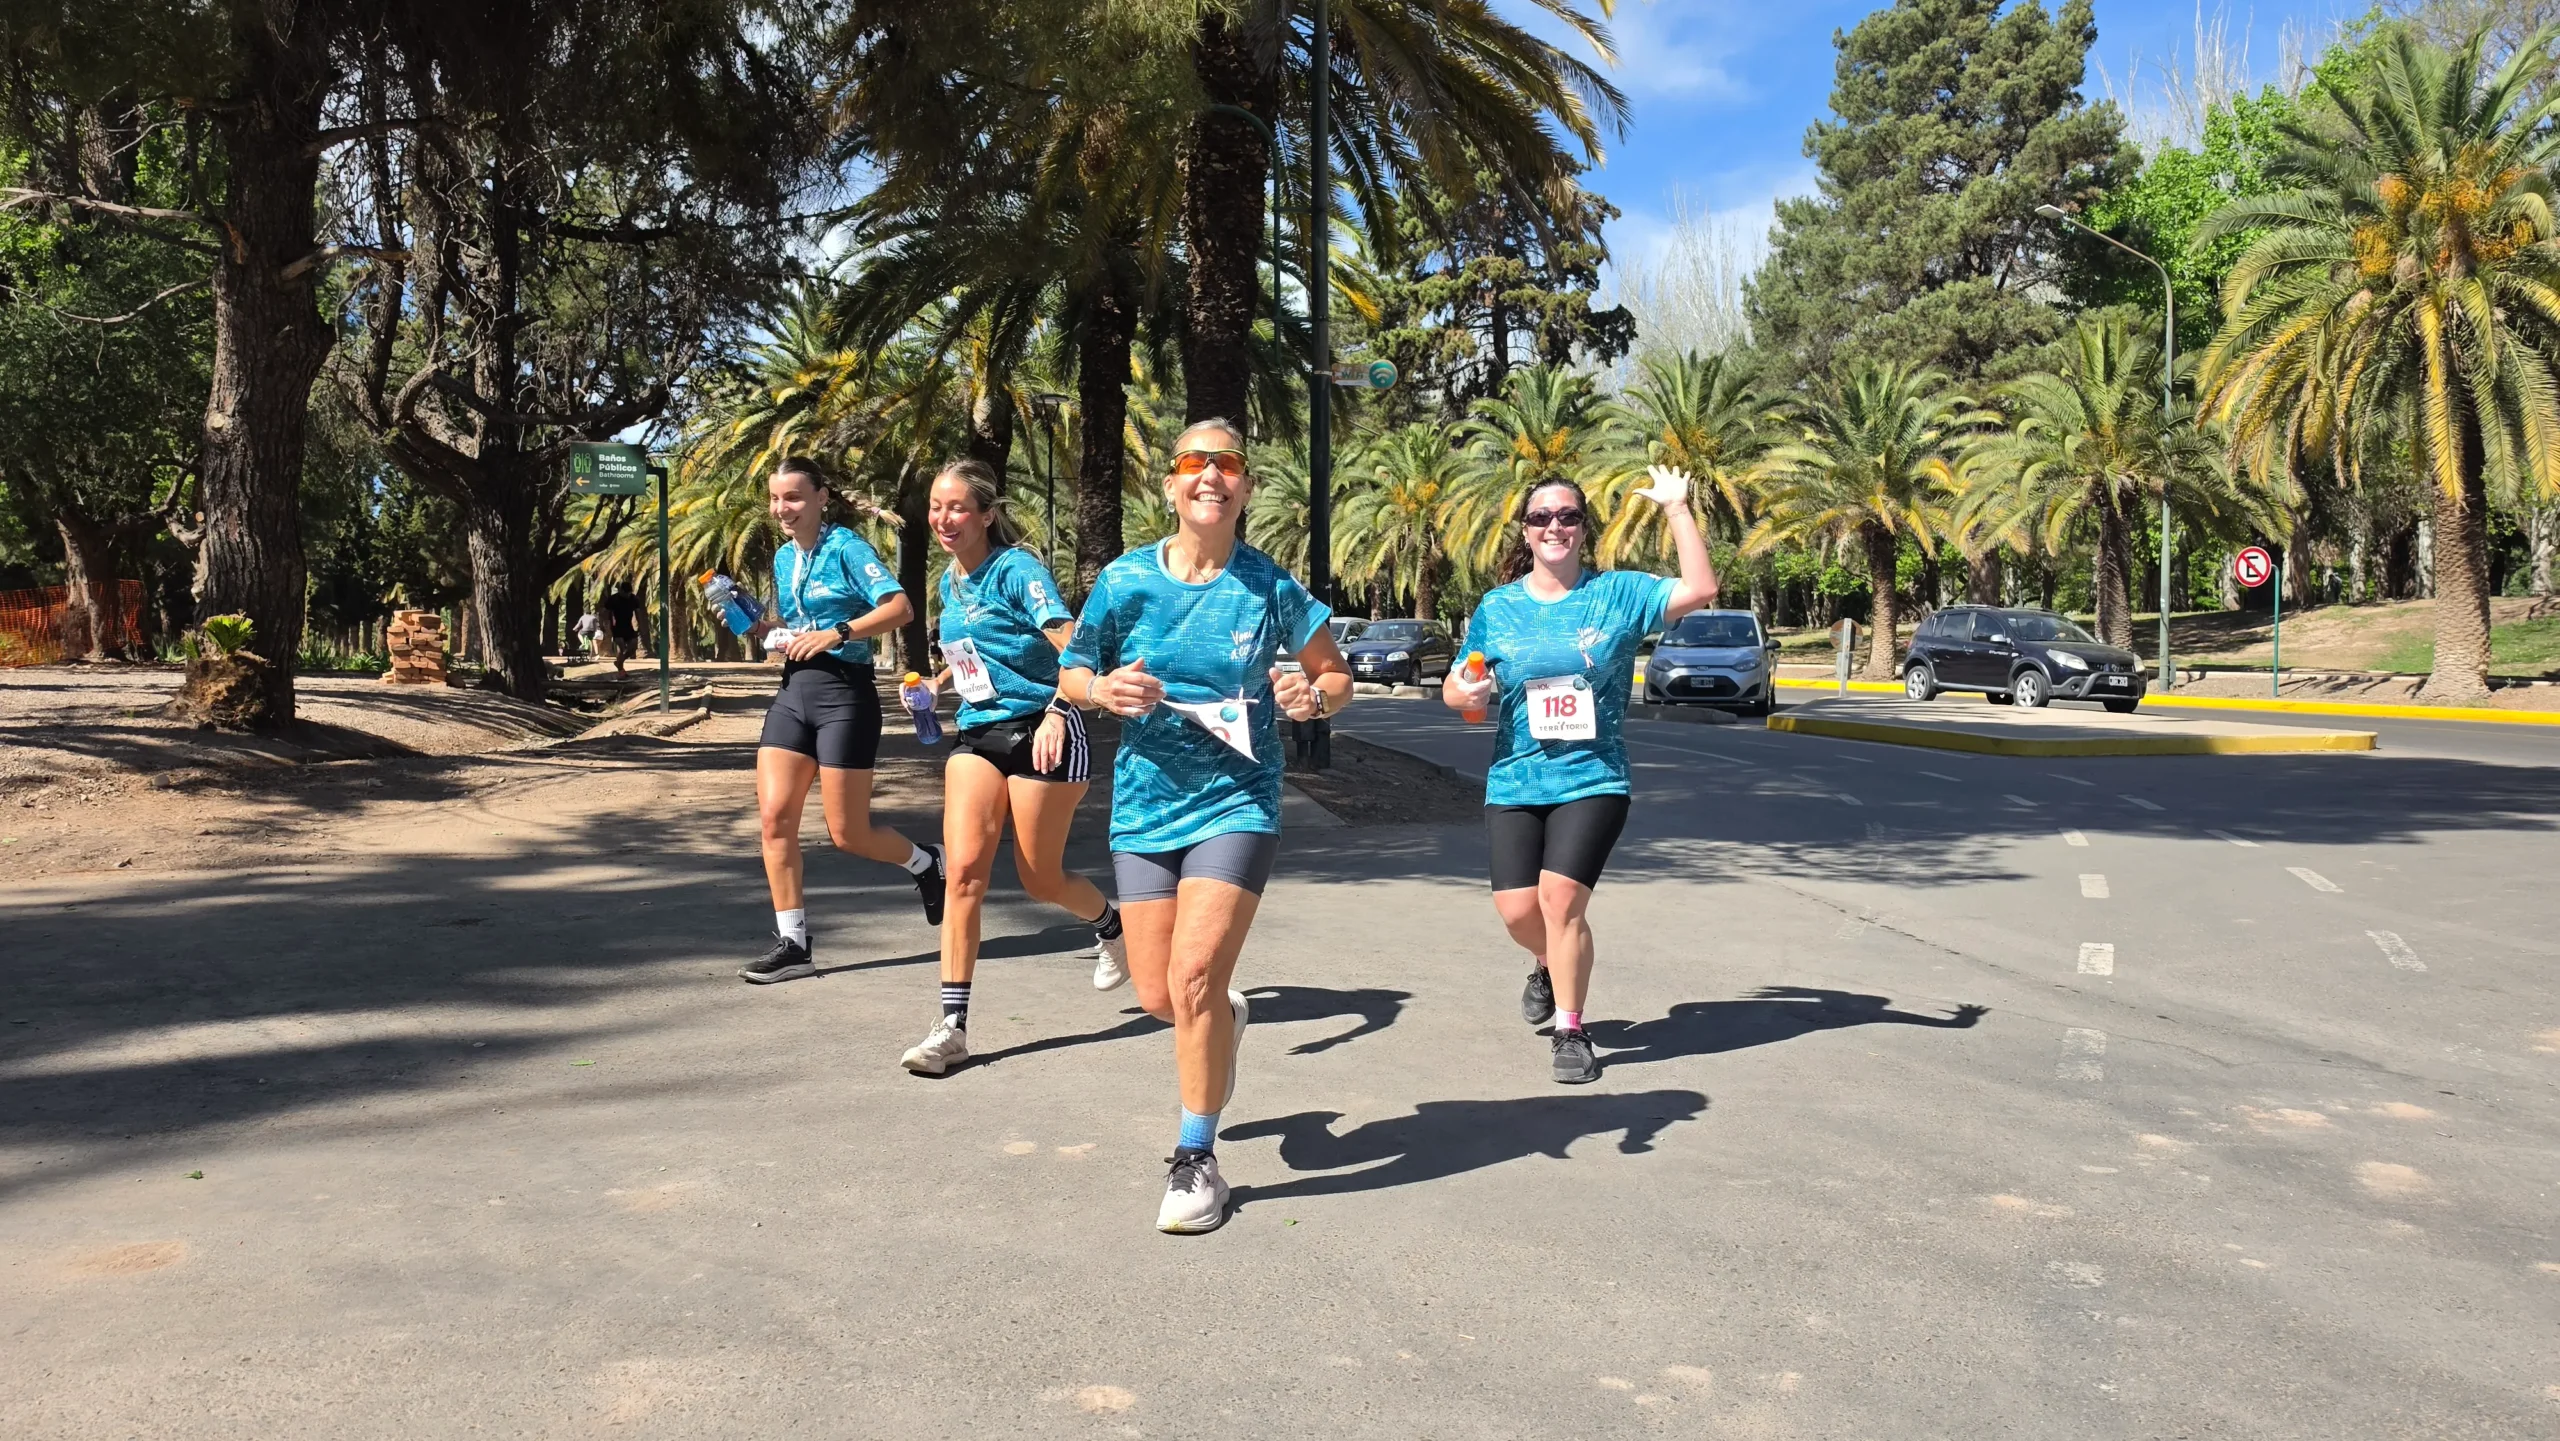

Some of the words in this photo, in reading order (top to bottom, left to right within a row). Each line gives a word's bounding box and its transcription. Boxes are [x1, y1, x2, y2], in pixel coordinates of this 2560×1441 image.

[599, 454, 626, 462] Baños
[599, 463, 637, 472] Públicos
[957, 657, 978, 680] 114
[1542, 694, 1577, 718] 118
